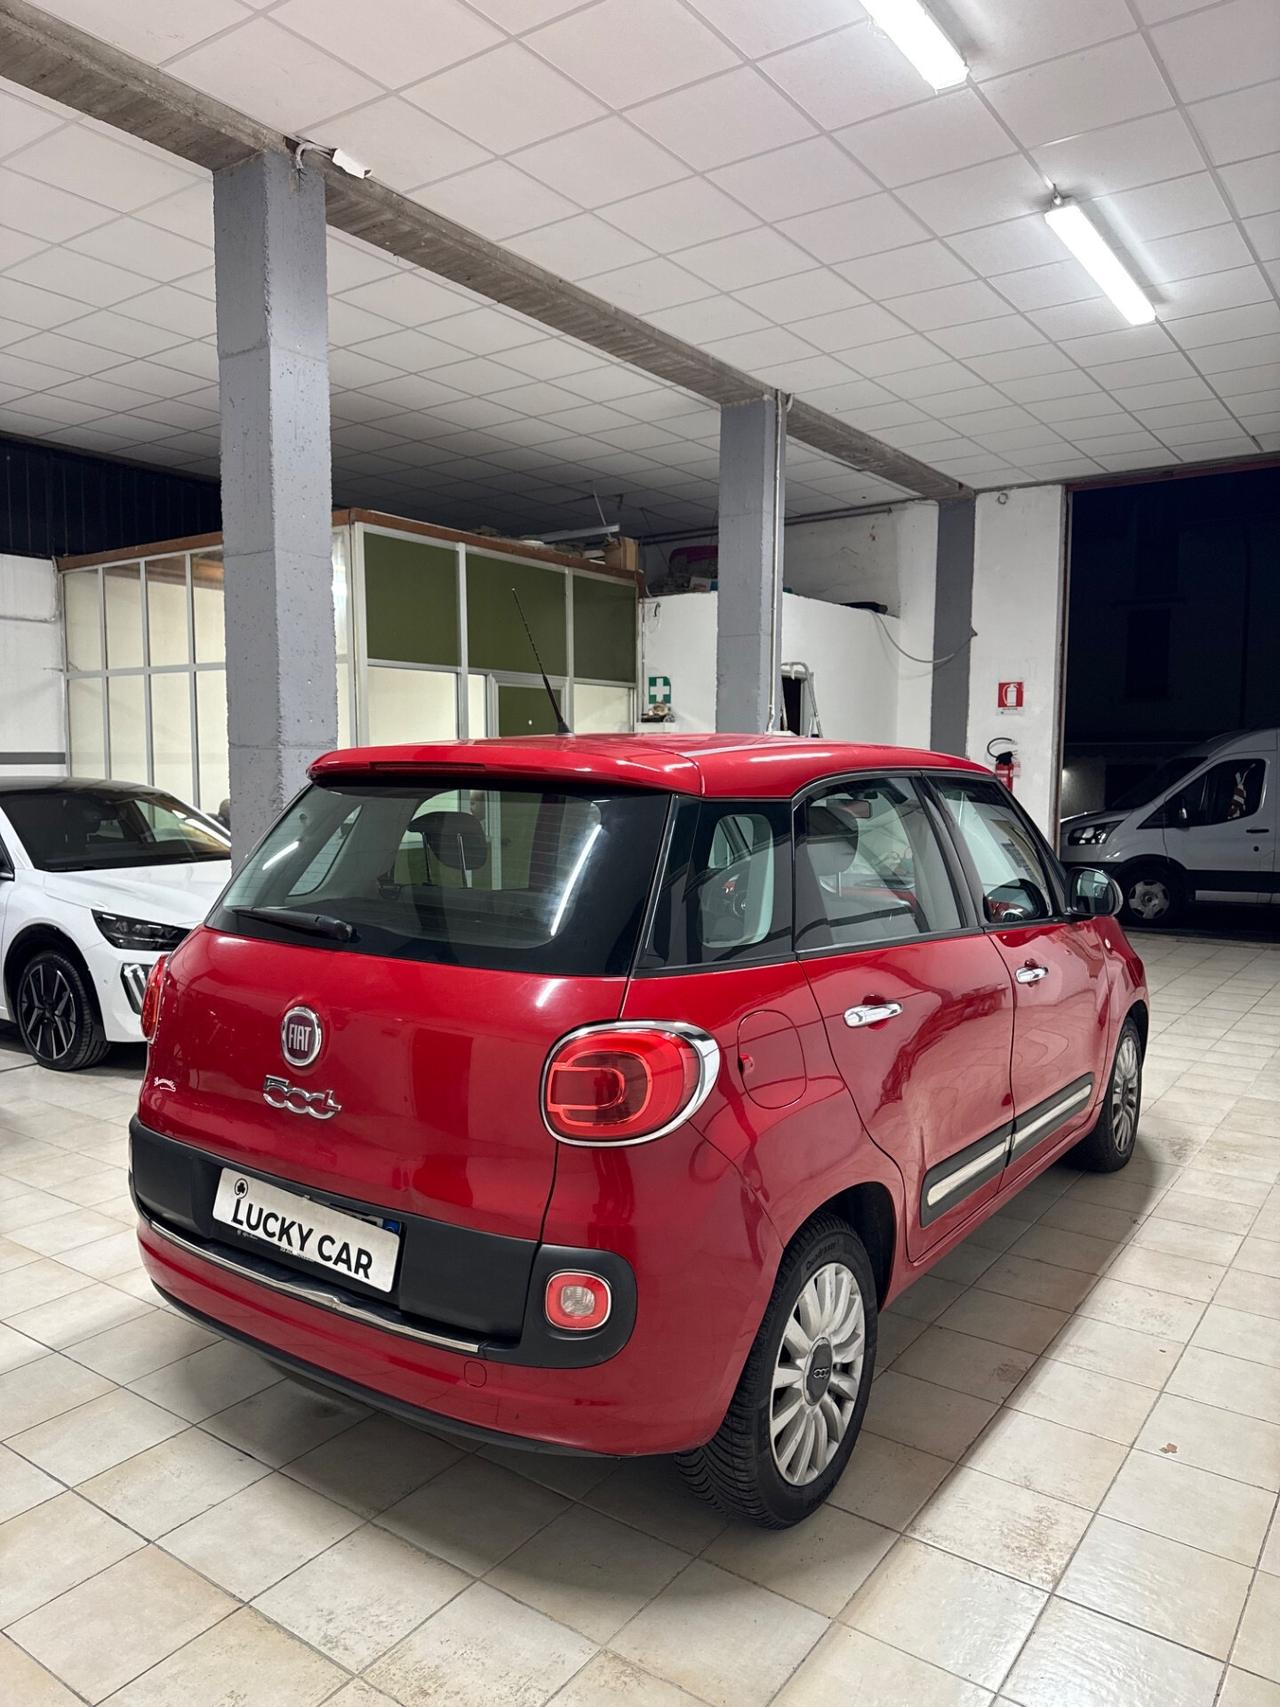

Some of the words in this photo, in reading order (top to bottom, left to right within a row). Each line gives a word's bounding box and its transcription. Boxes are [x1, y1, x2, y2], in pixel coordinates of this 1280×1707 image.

[288, 1023, 312, 1051] FIAT
[231, 1199, 314, 1252] LUCKY
[317, 1234, 373, 1280] CAR
